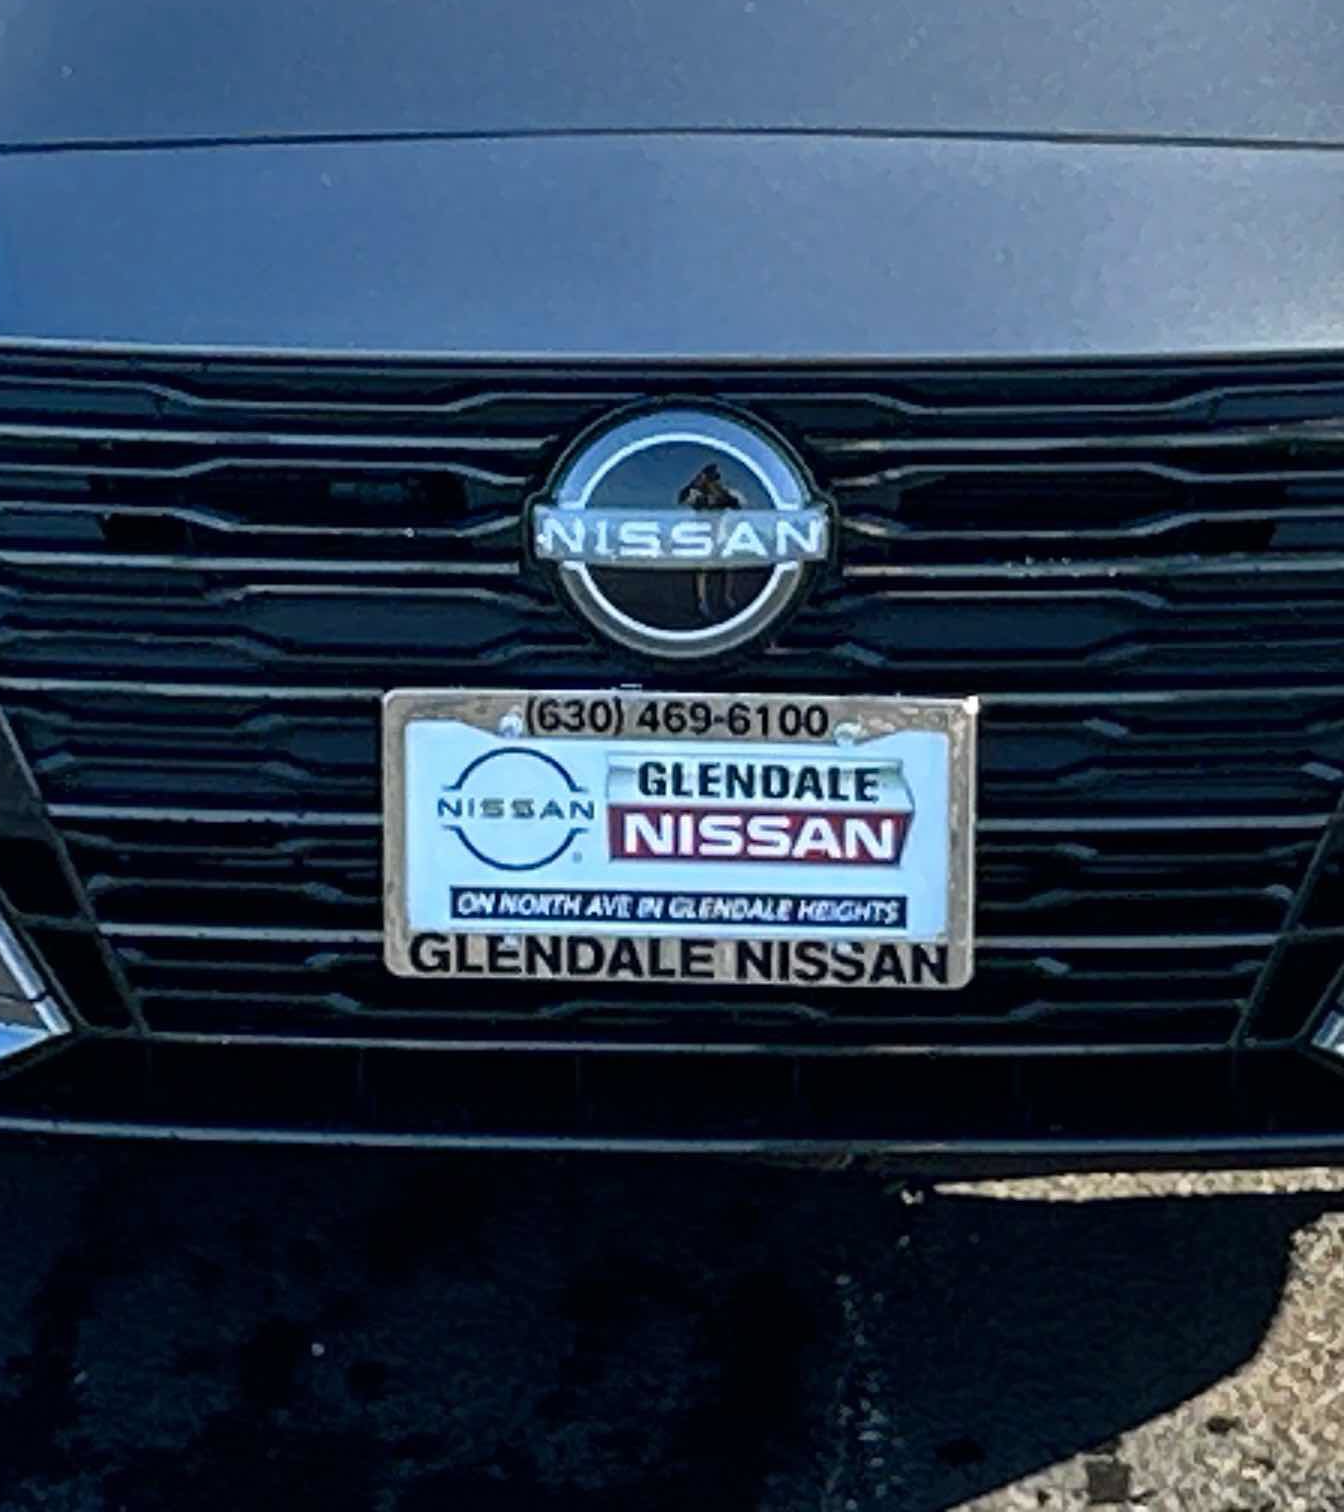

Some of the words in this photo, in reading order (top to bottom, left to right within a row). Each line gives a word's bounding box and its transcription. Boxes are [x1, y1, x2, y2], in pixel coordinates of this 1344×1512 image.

[541, 520, 825, 558] NISSAN
[526, 696, 625, 736] (630)
[636, 701, 829, 737] 469-6100
[637, 761, 881, 802] GLENDALE
[437, 797, 595, 820] NISSAN
[623, 814, 895, 860] NISSAN
[457, 893, 492, 914] ON
[497, 893, 581, 917] NORTH
[585, 895, 631, 918] AVE
[637, 897, 662, 919] IN
[668, 897, 793, 921] GLENDALE
[798, 899, 898, 925] HEIGHTS
[409, 934, 715, 977] GLENDALE
[736, 940, 949, 985] NISSAN
